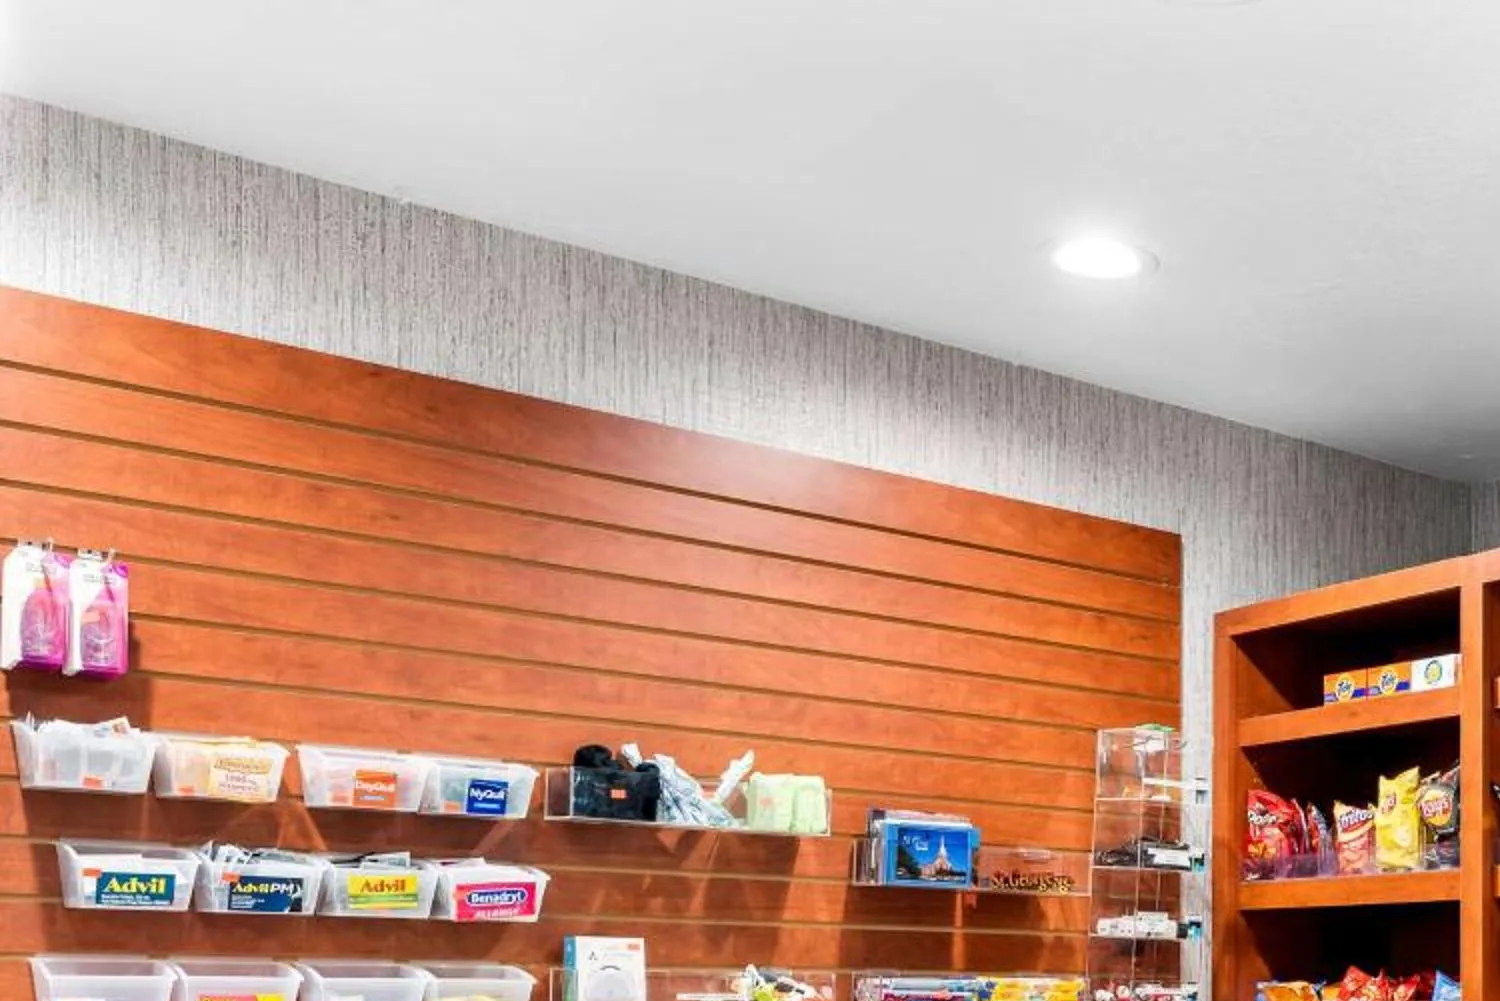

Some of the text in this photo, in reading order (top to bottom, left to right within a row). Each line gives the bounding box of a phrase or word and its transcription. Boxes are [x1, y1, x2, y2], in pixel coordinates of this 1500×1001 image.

[470, 788, 504, 801] NyQuil
[104, 877, 166, 893] Advil
[360, 879, 406, 893] Advil
[471, 891, 522, 905] Benadryl
